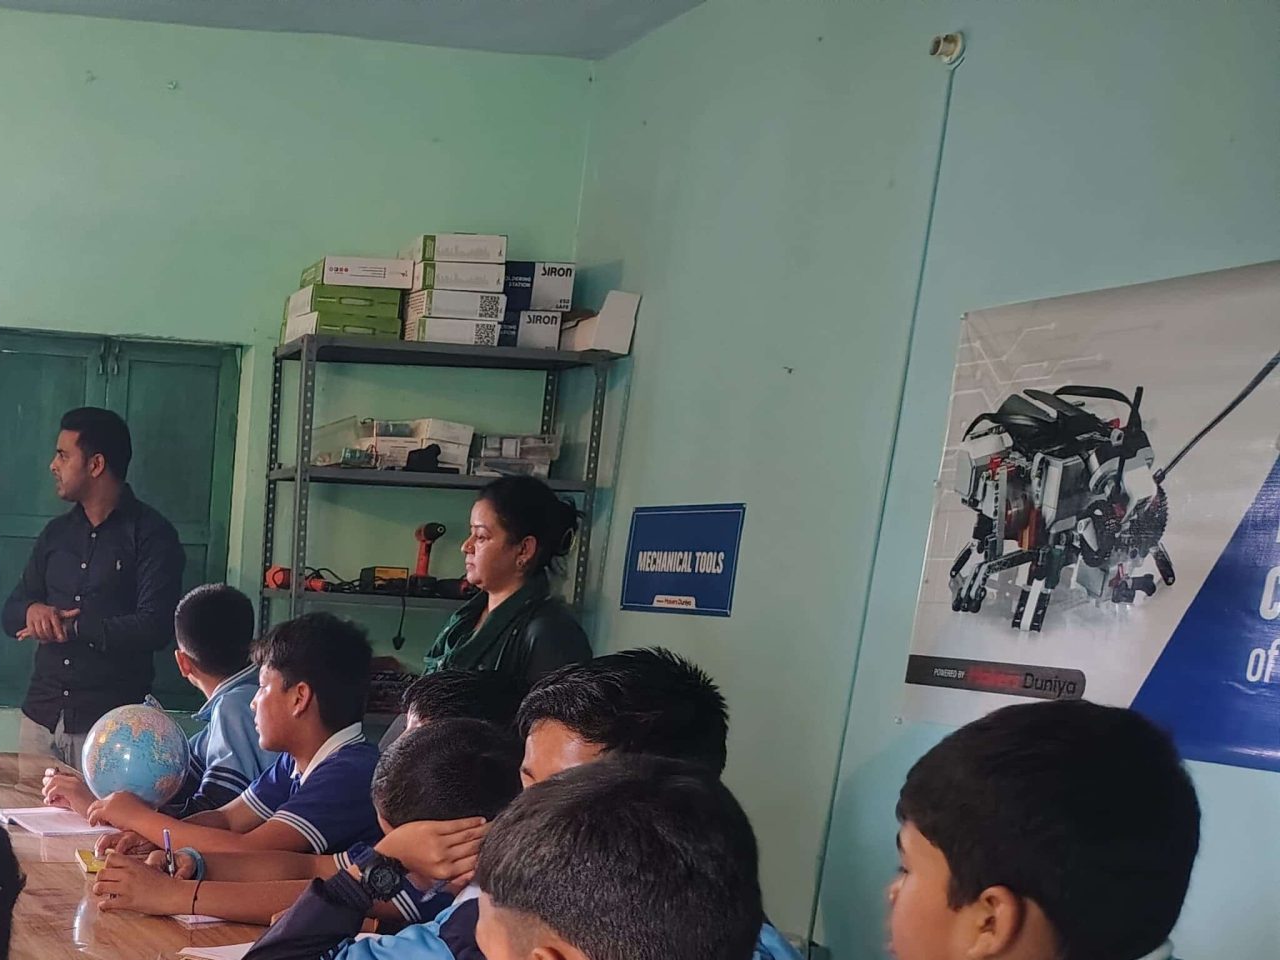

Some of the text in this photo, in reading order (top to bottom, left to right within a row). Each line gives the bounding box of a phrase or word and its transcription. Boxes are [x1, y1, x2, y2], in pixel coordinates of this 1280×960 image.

[541, 266, 573, 278] SIRON
[526, 314, 558, 325] SIRON
[636, 550, 725, 574] MECHANICAL TOOLS
[933, 667, 957, 679] POWERED
[957, 669, 966, 679] BY
[1023, 672, 1078, 698] Duniya
